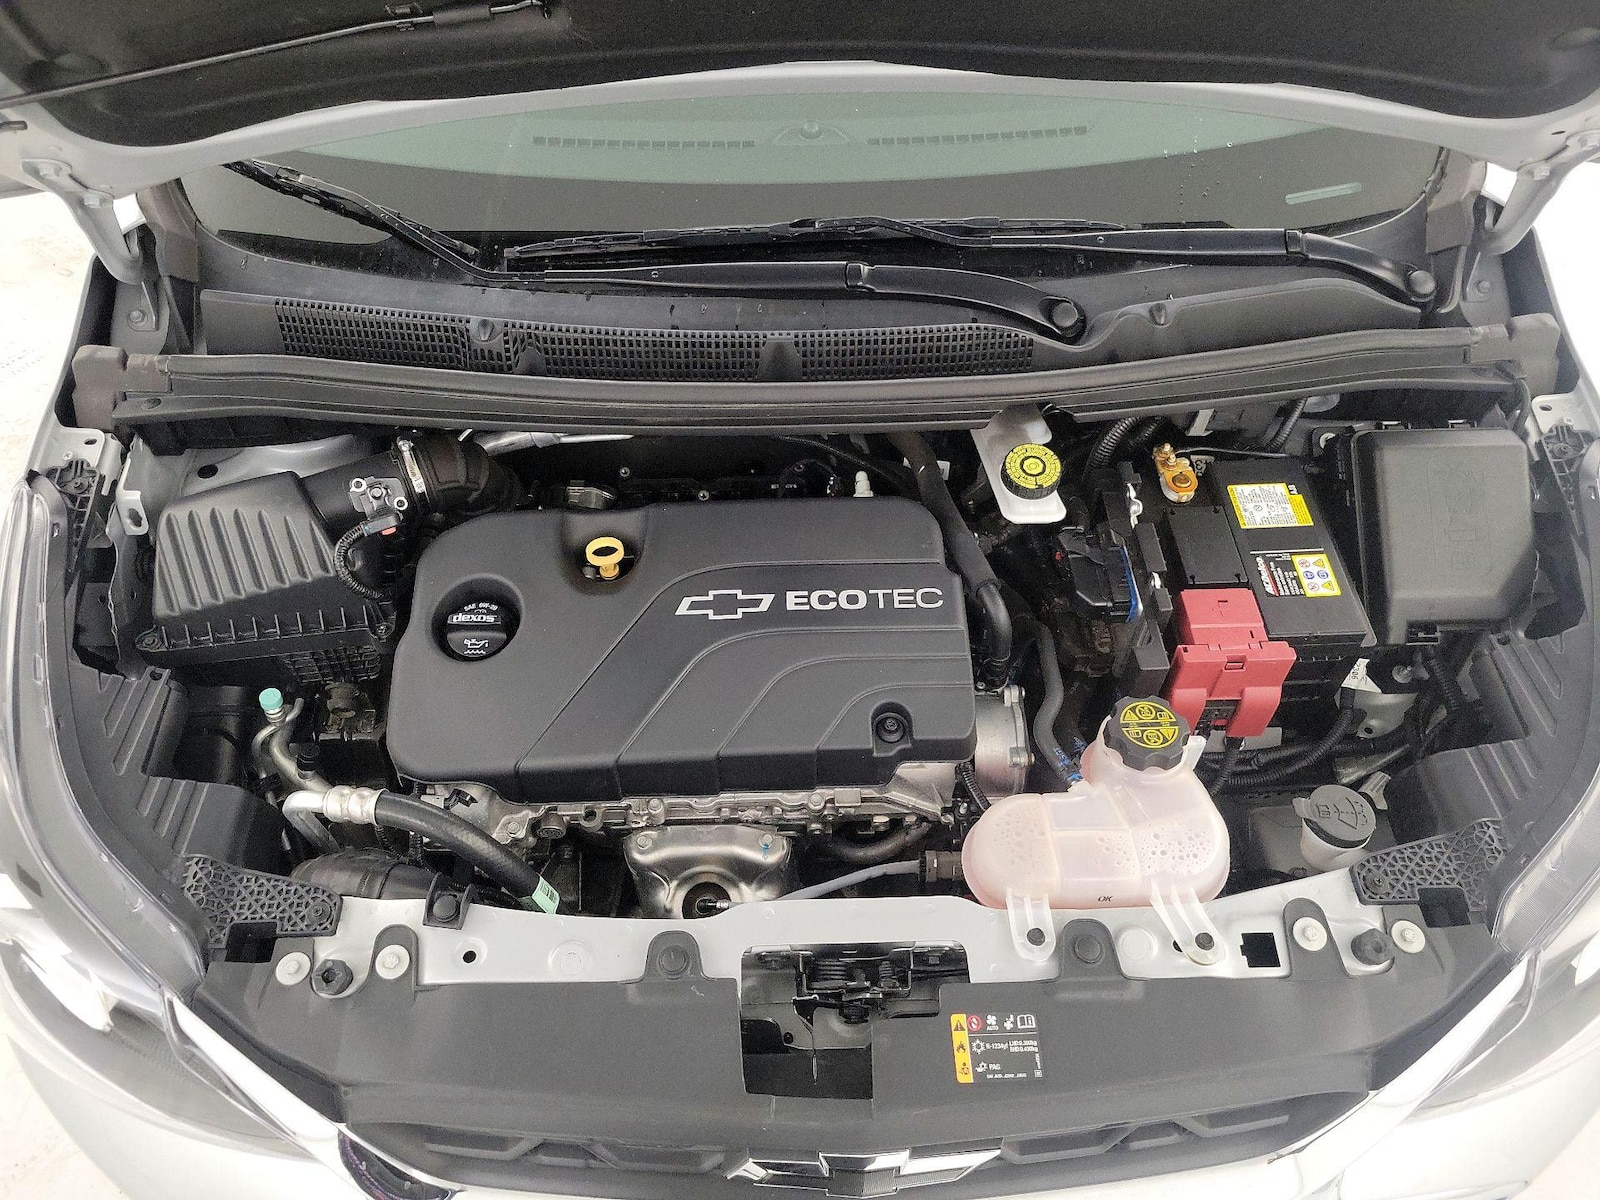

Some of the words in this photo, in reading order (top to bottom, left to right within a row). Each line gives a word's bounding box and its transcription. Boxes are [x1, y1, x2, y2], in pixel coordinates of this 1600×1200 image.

[1256, 555, 1275, 596] ACDelco
[786, 587, 944, 611] ECOTEC
[452, 613, 497, 623] dexos
